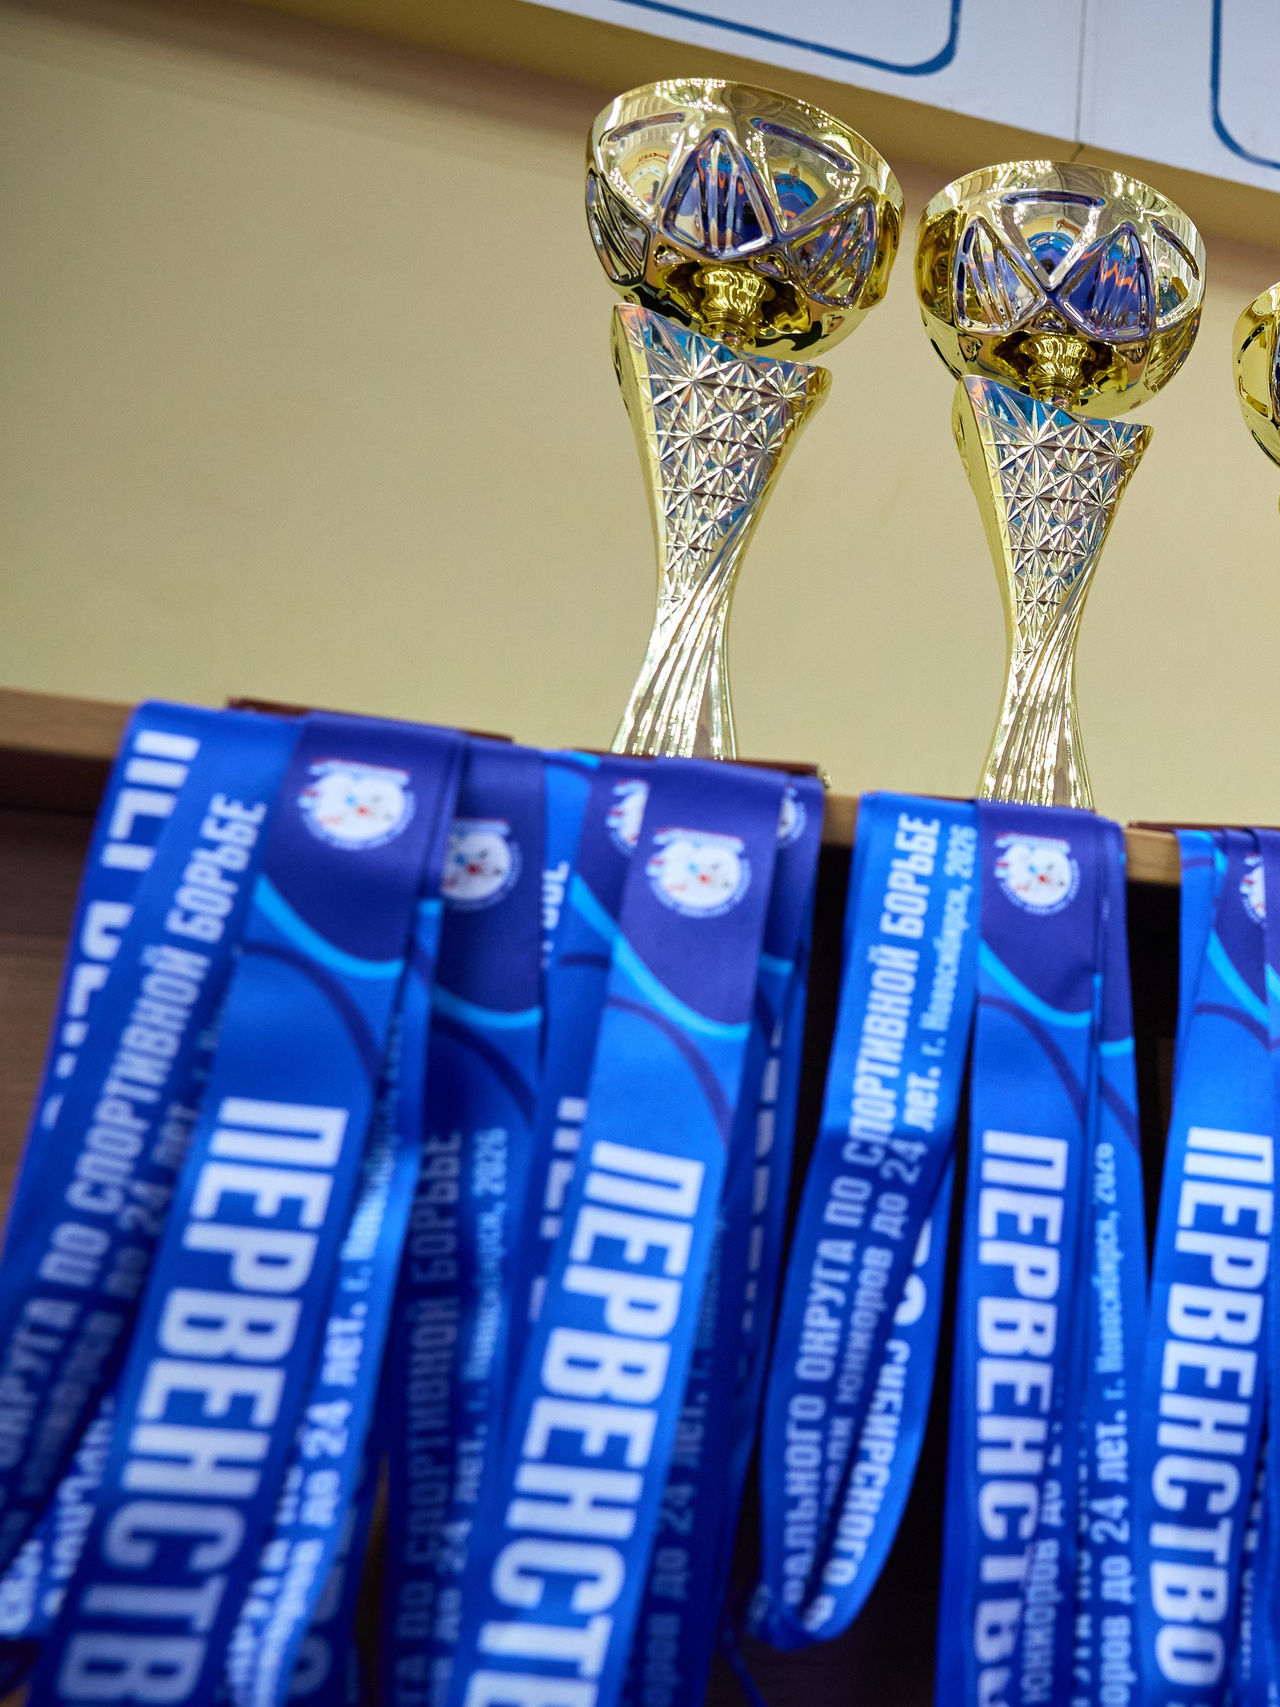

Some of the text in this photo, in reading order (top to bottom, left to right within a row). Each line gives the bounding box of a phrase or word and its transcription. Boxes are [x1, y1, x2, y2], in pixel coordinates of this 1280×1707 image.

[880, 812, 940, 940] БОРЬБЕ
[942, 825, 979, 880] 2026
[66, 944, 211, 1214] СПОРТИВНОЙ
[164, 793, 267, 944] БОРЬБЕ
[843, 944, 920, 1165] СПОРТИВНОЙ
[920, 1036, 946, 1058] г.
[903, 1063, 942, 1134] лет.
[880, 1137, 928, 1185] 24
[412, 1131, 462, 1283] БОРЬБЕ
[824, 1175, 873, 1228] ПО
[870, 1191, 910, 1240] до
[796, 1238, 857, 1382] ОКРУГА
[53, 1096, 350, 1707] ПЕРВЕНСТВ
[1149, 1126, 1275, 1688] ПЕРВЕНСТВО
[1094, 1408, 1130, 1484] лет.
[1087, 1493, 1131, 1546] 24
[1099, 1553, 1138, 1604] до
